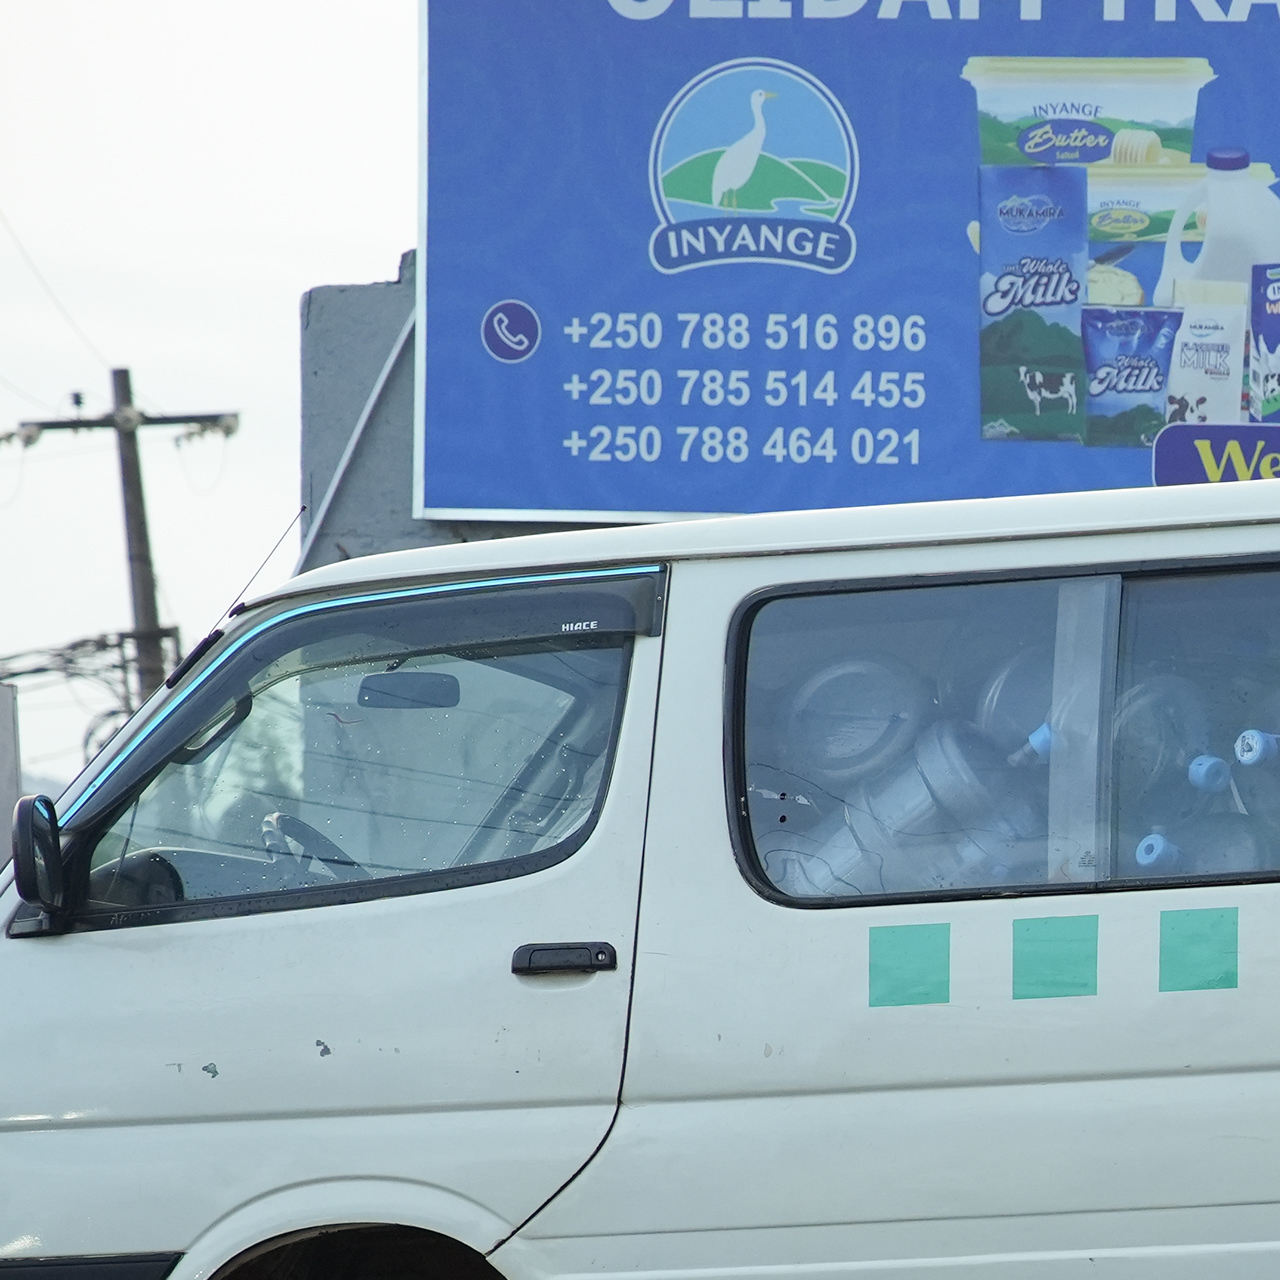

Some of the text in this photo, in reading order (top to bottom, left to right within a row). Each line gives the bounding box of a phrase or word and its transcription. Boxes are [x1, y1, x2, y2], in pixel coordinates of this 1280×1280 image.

[1032, 102, 1103, 118] INYANGE
[1024, 123, 1109, 153] Butter
[999, 206, 1065, 219] MUKAMIRA
[667, 223, 841, 263] INYANGE
[1020, 258, 1067, 274] Whole
[983, 272, 1080, 316] Milk
[562, 312, 926, 351] +250 788 516 896
[1115, 355, 1157, 368] Whole
[1180, 350, 1231, 371] MILK
[562, 369, 926, 408] +250 785 514 455
[1089, 365, 1164, 395] Milk
[561, 426, 920, 465] +250 788 464 021
[561, 620, 599, 632] HIACE
